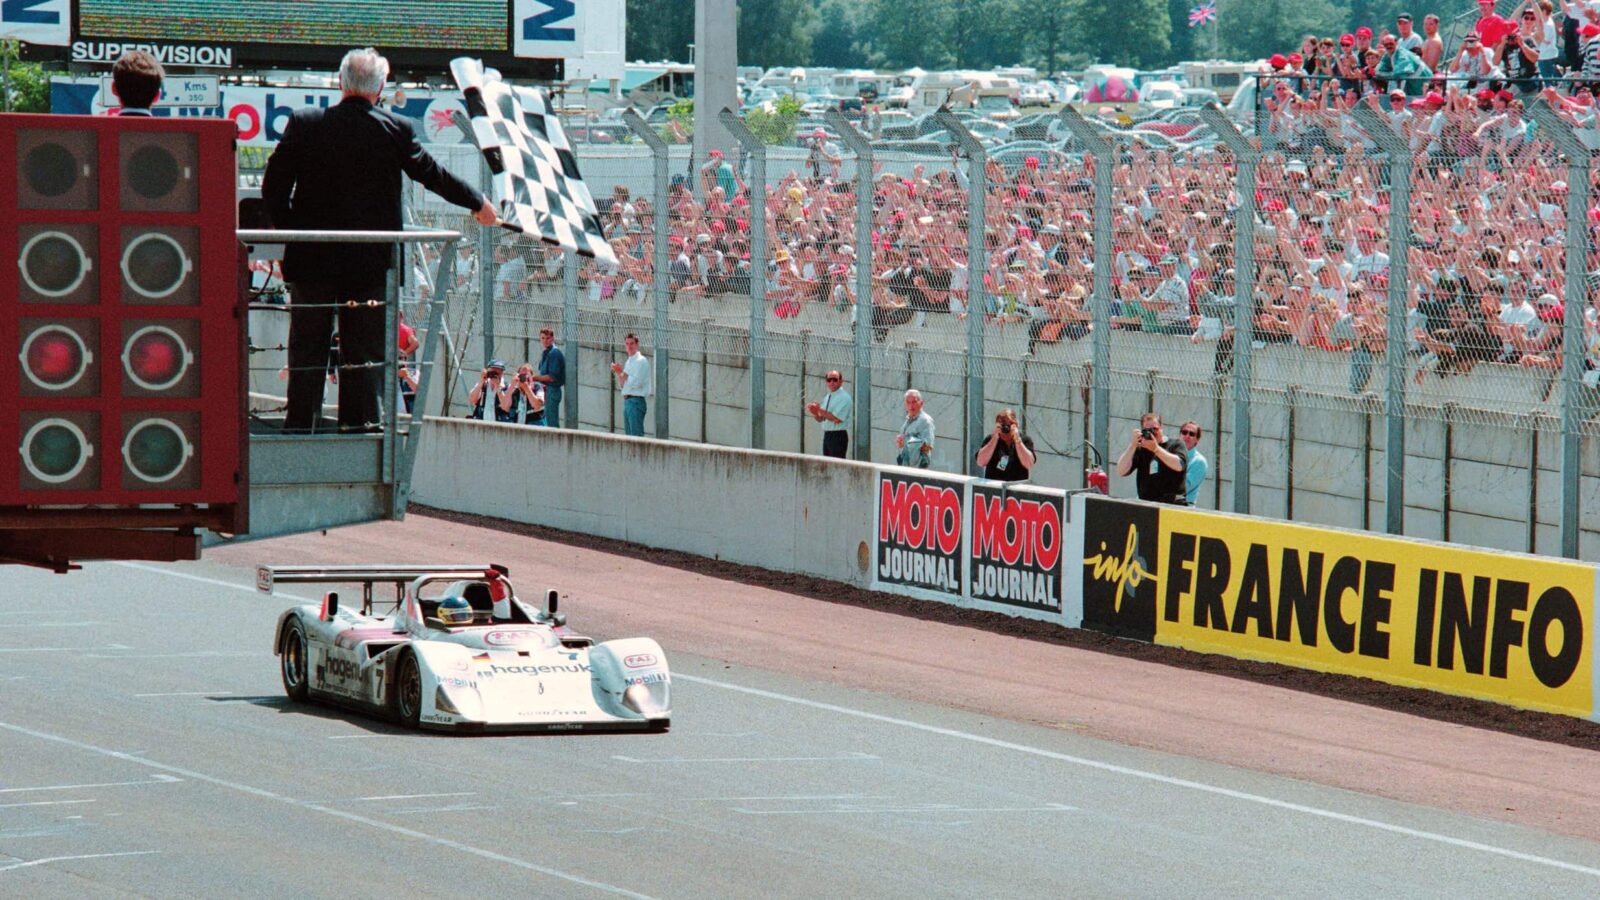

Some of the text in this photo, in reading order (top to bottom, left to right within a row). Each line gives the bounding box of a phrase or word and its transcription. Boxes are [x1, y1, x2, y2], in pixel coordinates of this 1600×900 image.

[184, 81, 208, 91] Kms
[880, 479, 961, 555] MOTO
[972, 492, 1062, 571] MOTO
[880, 547, 959, 590] JOURNAL
[972, 564, 1058, 607] JOURNAL
[1083, 523, 1158, 613] info
[1164, 531, 1584, 689] FRANCE INFO
[376, 668, 384, 699] 7
[490, 664, 595, 676] hagenuk
